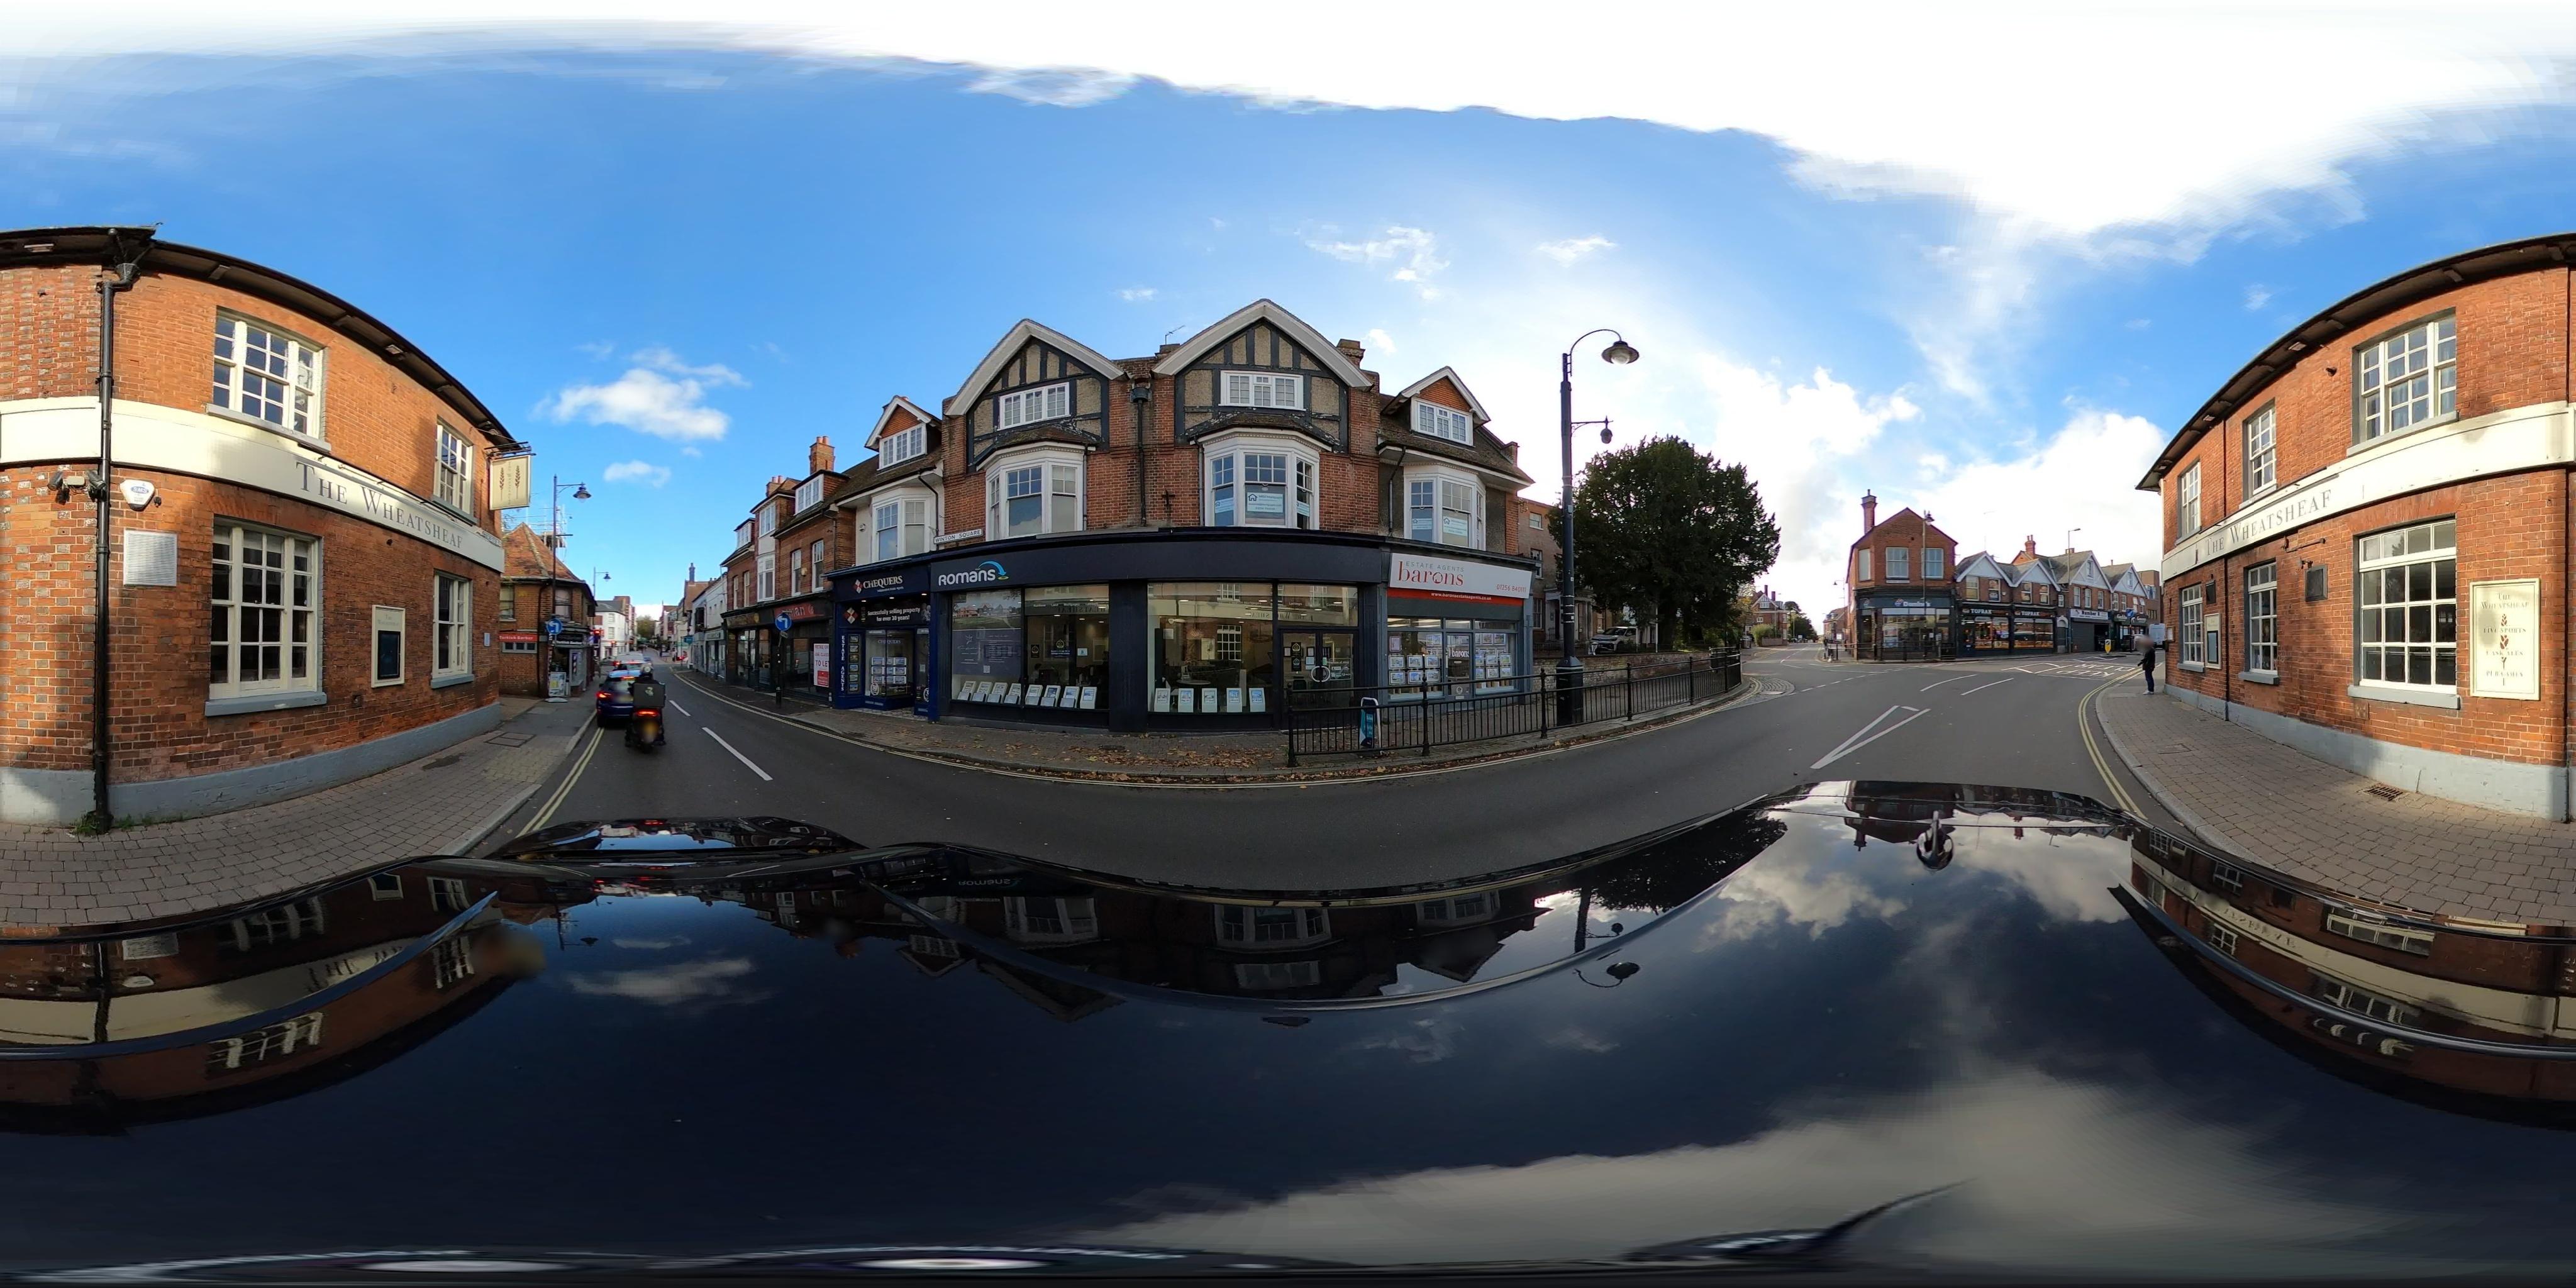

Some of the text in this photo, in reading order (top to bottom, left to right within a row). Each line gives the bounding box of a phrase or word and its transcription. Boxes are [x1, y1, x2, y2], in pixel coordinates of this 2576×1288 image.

[296, 462, 463, 549] THE WHEATSHEAF
[2206, 489, 2331, 556] THE WHEATSHEAF
[935, 530, 980, 543] WINTON SQUARE
[1398, 560, 1463, 586] barons
[1406, 561, 1465, 572] ESTATE AGENTS
[863, 575, 903, 589] CHEQUERS
[1431, 592, 1492, 601] www.baronsestateagents.co.uk
